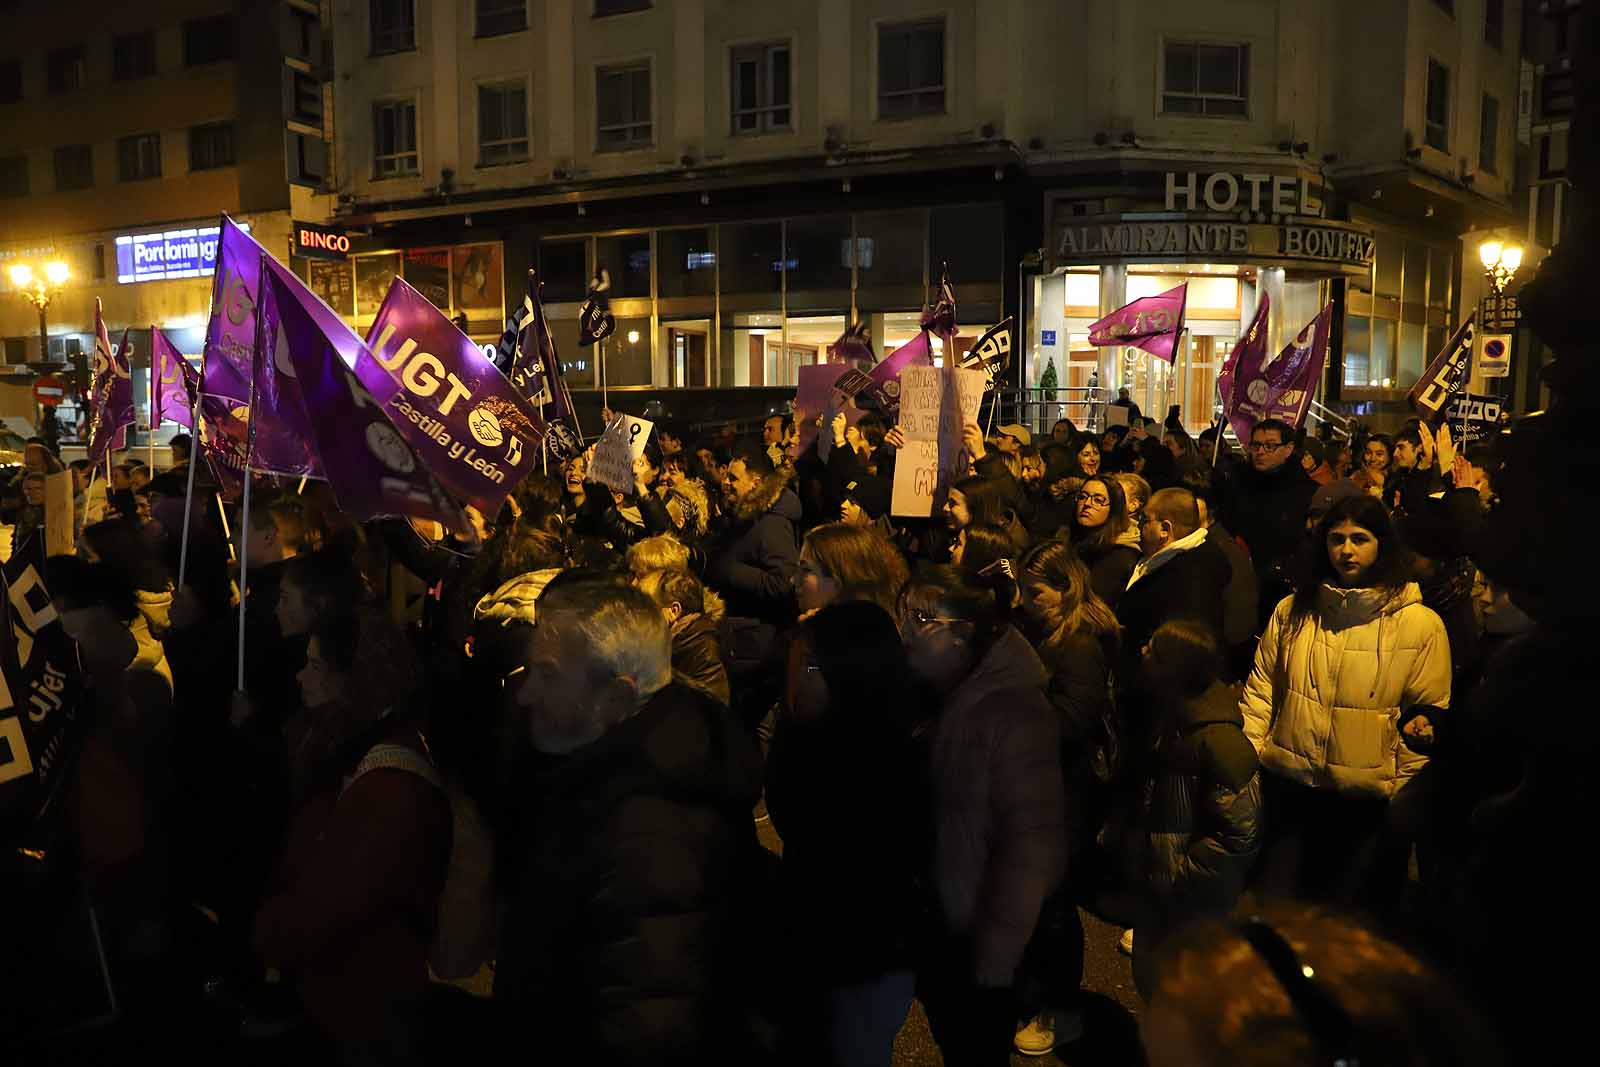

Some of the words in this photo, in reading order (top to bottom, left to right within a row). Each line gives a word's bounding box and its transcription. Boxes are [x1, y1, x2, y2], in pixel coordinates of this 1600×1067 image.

[1165, 171, 1323, 216] HOTEL
[134, 236, 219, 264] Pordoming
[300, 229, 350, 252] BINGO
[1058, 223, 1250, 256] ALMIRANTE
[1284, 226, 1375, 260] BONIFAZ
[373, 323, 472, 417] UGT
[388, 392, 451, 447] Castilla
[448, 441, 465, 459] y
[463, 448, 506, 484] León
[28, 660, 67, 722] ujer
